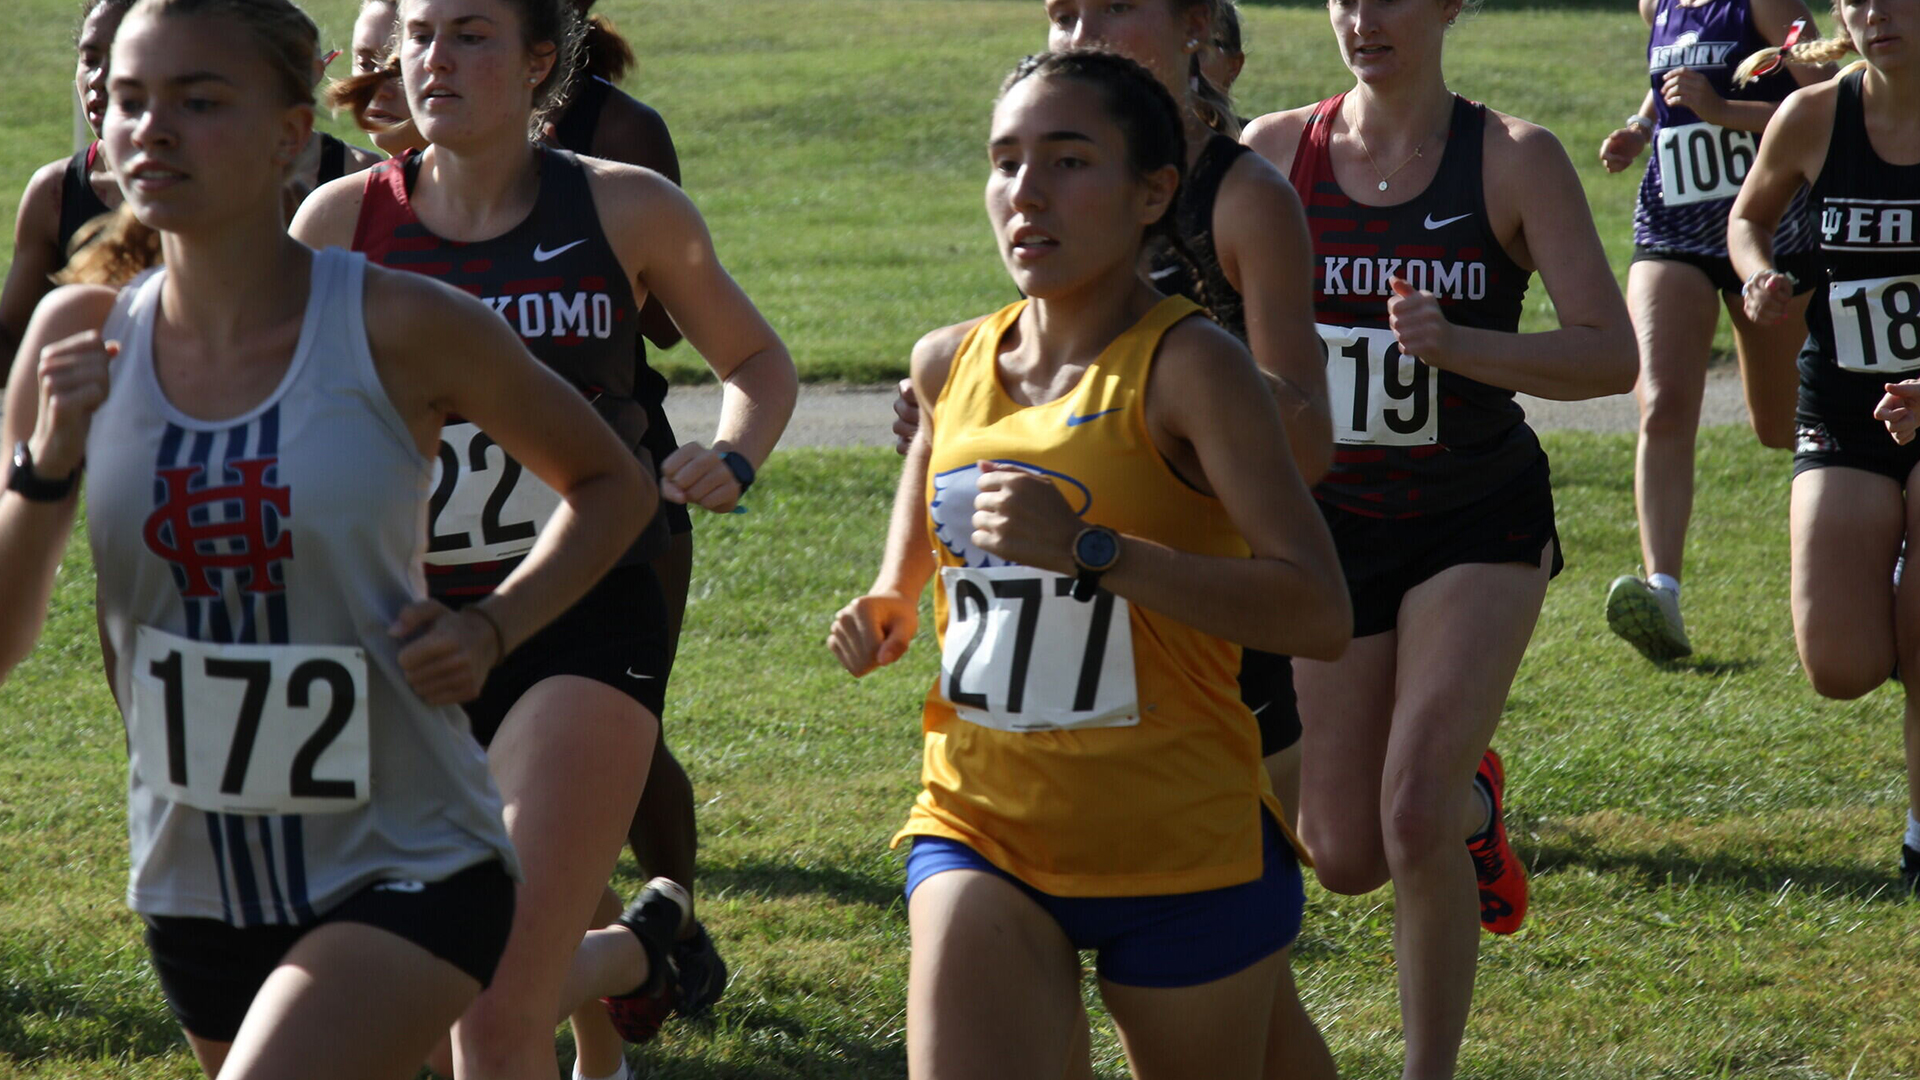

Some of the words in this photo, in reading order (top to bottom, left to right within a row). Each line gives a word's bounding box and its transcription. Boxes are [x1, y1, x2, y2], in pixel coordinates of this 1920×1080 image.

[1665, 128, 1755, 195] 106
[1323, 256, 1486, 301] KOKOMO
[1841, 281, 1920, 366] 18
[1315, 331, 1430, 435] 19
[948, 577, 1115, 713] 277
[150, 649, 357, 800] 172
